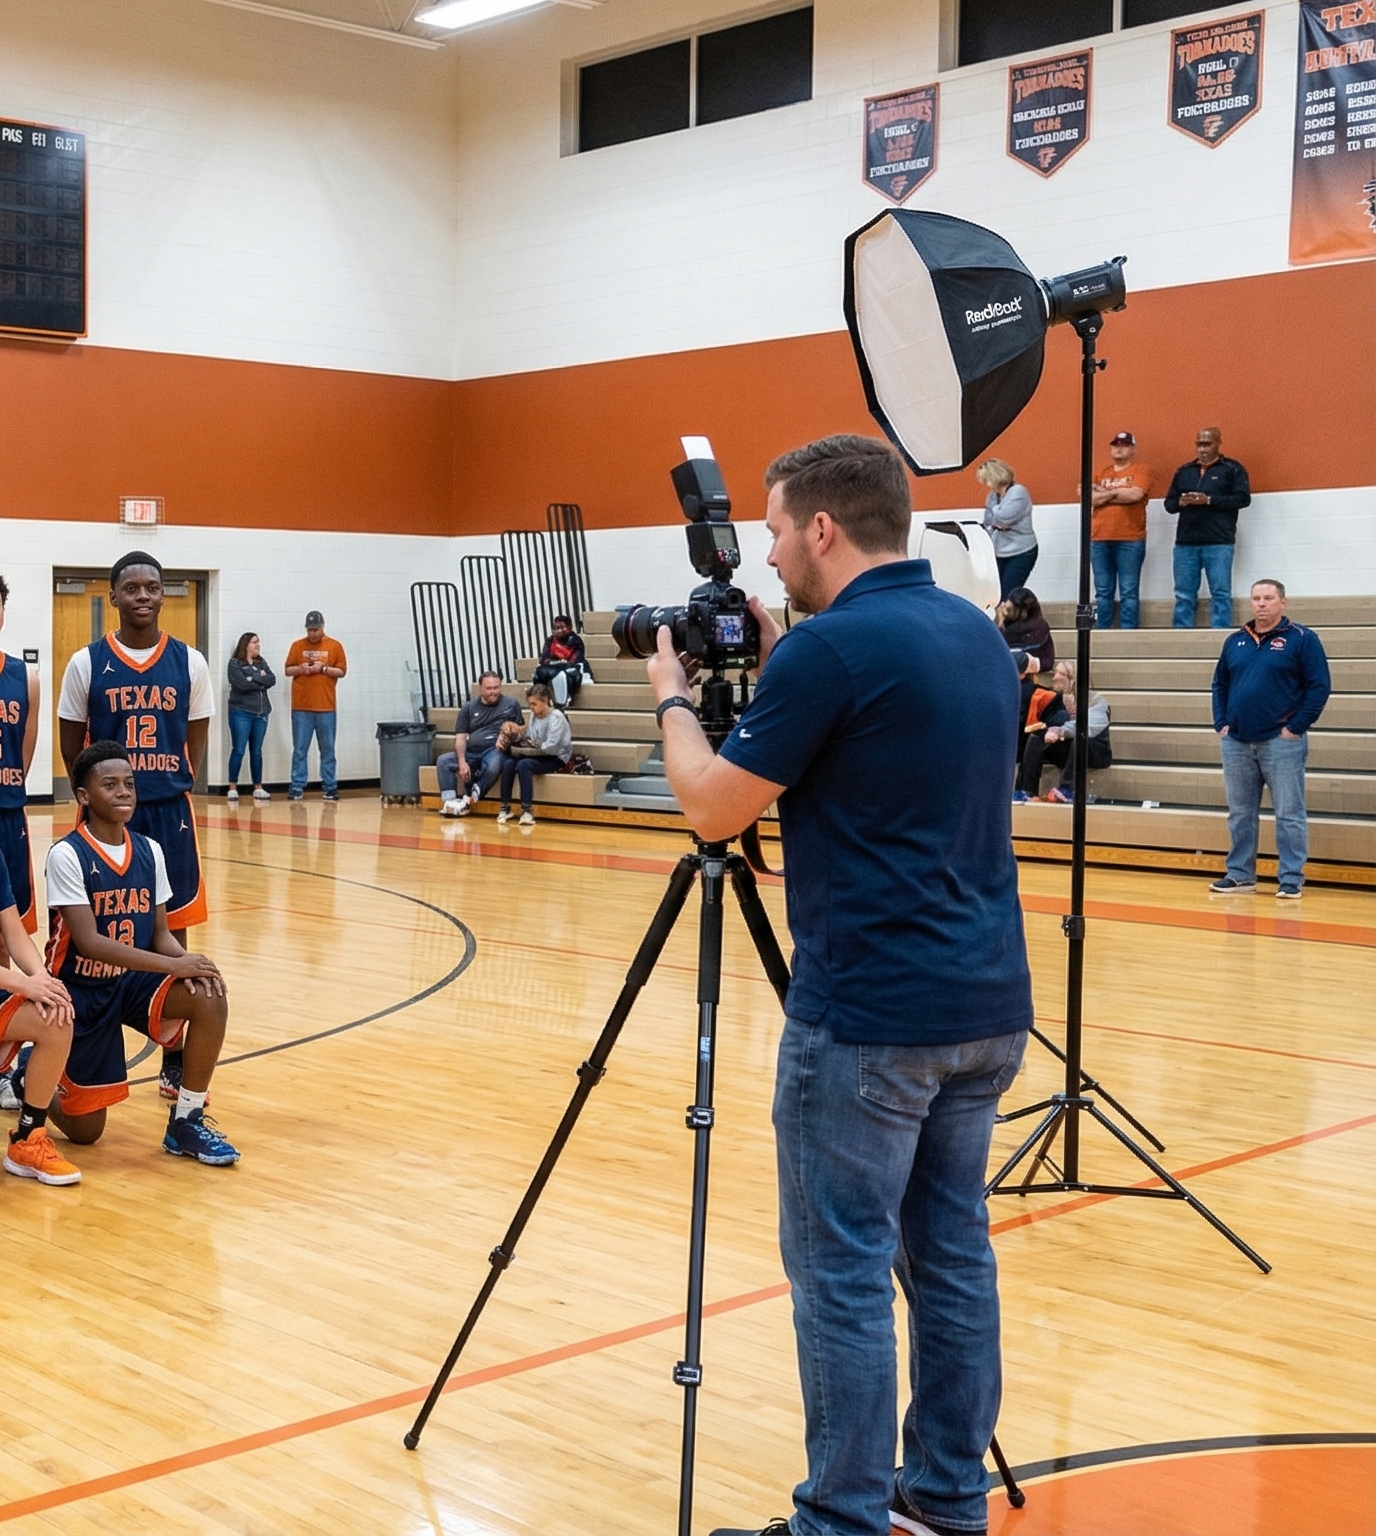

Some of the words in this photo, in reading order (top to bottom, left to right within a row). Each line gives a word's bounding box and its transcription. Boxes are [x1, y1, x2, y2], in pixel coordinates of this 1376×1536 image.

[105, 685, 177, 713] TEXAS
[125, 714, 157, 748] 12
[127, 753, 180, 772] NADOES
[93, 887, 151, 916] TEXAS
